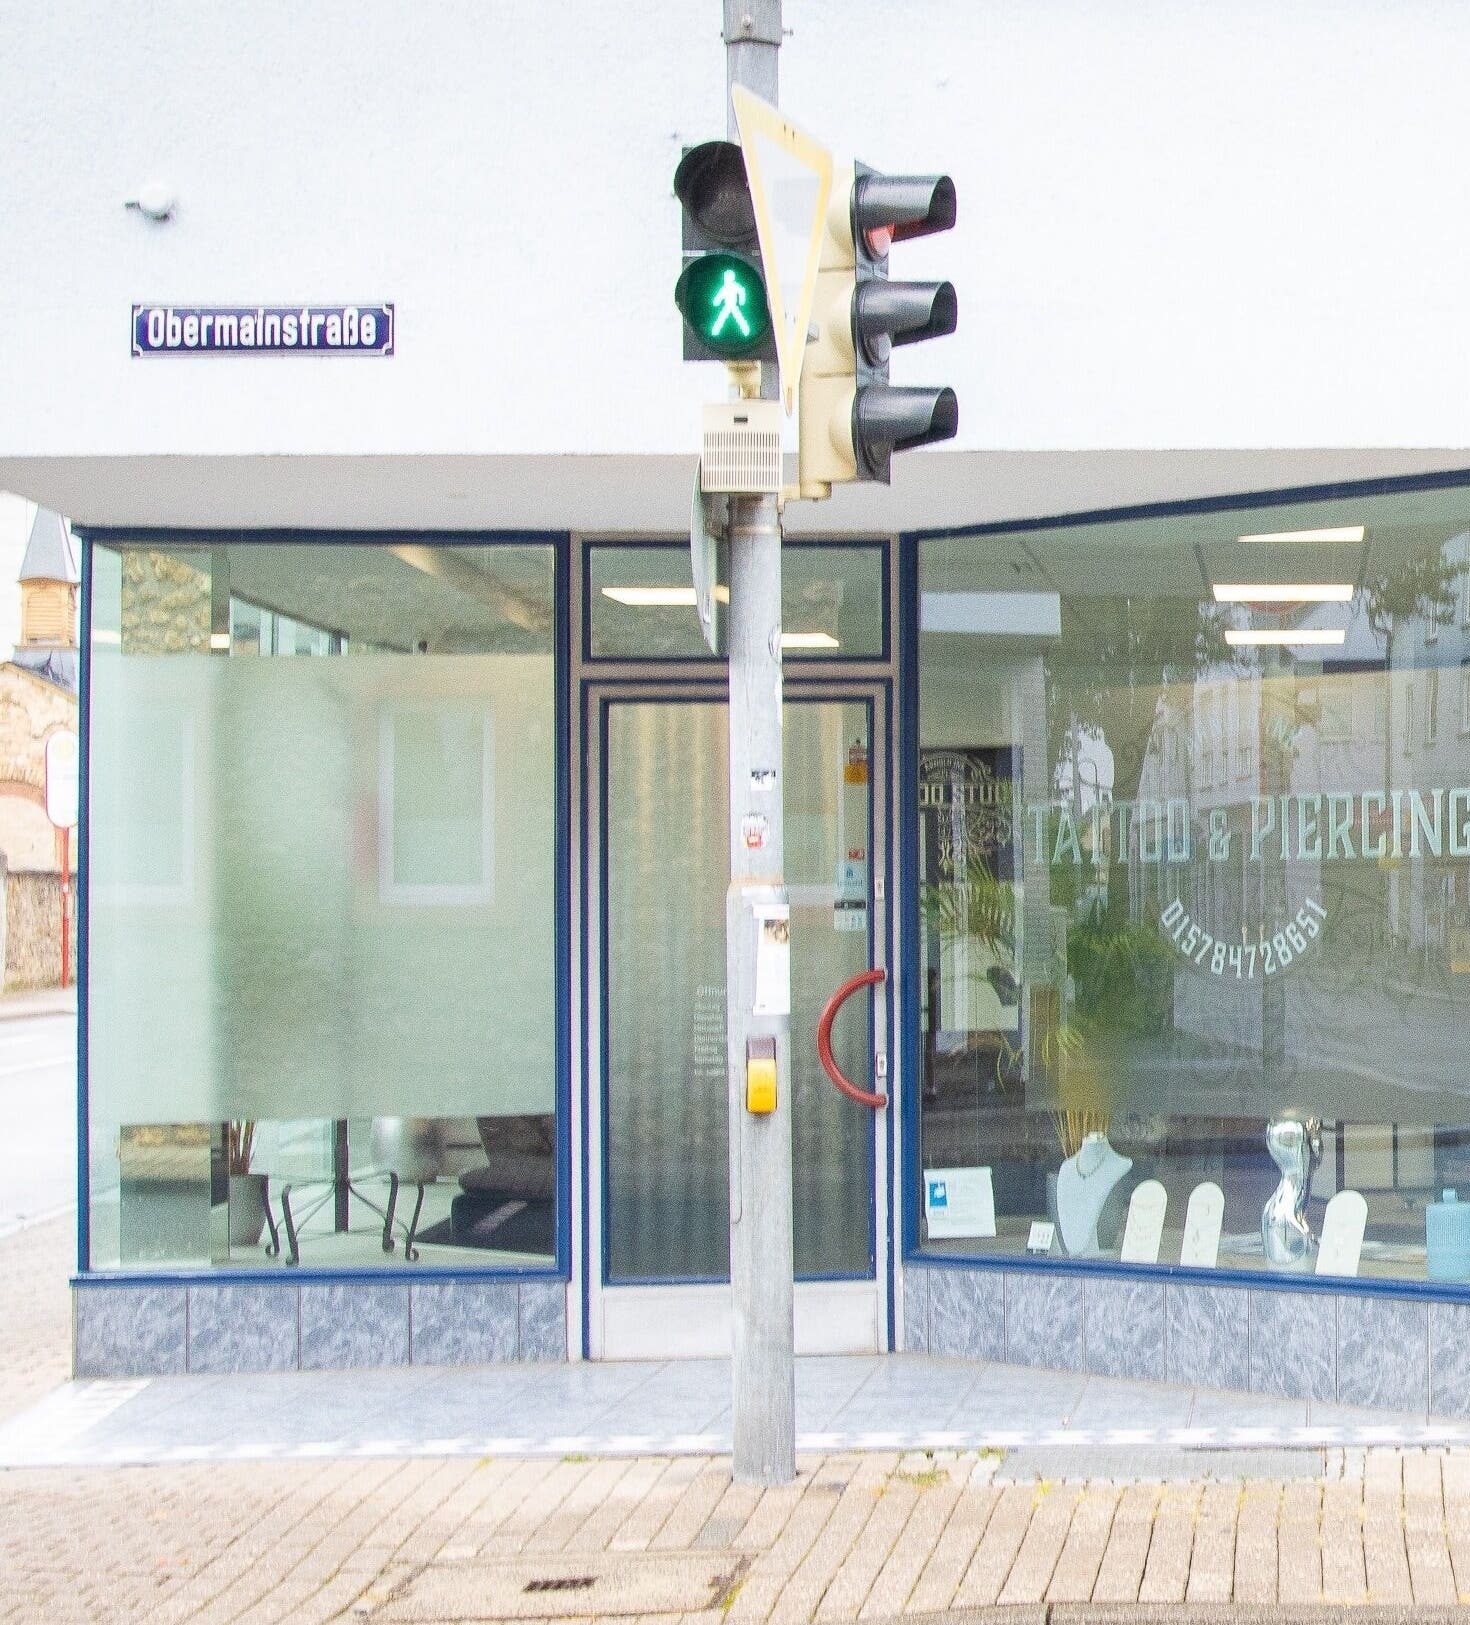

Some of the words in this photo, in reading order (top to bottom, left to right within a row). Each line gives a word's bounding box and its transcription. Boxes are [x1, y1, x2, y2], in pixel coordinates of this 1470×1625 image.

[147, 308, 376, 347] Obermainstraße
[1028, 798, 1194, 864] TATTOO
[1208, 808, 1230, 861] &
[1161, 897, 1328, 979] 015784728651
